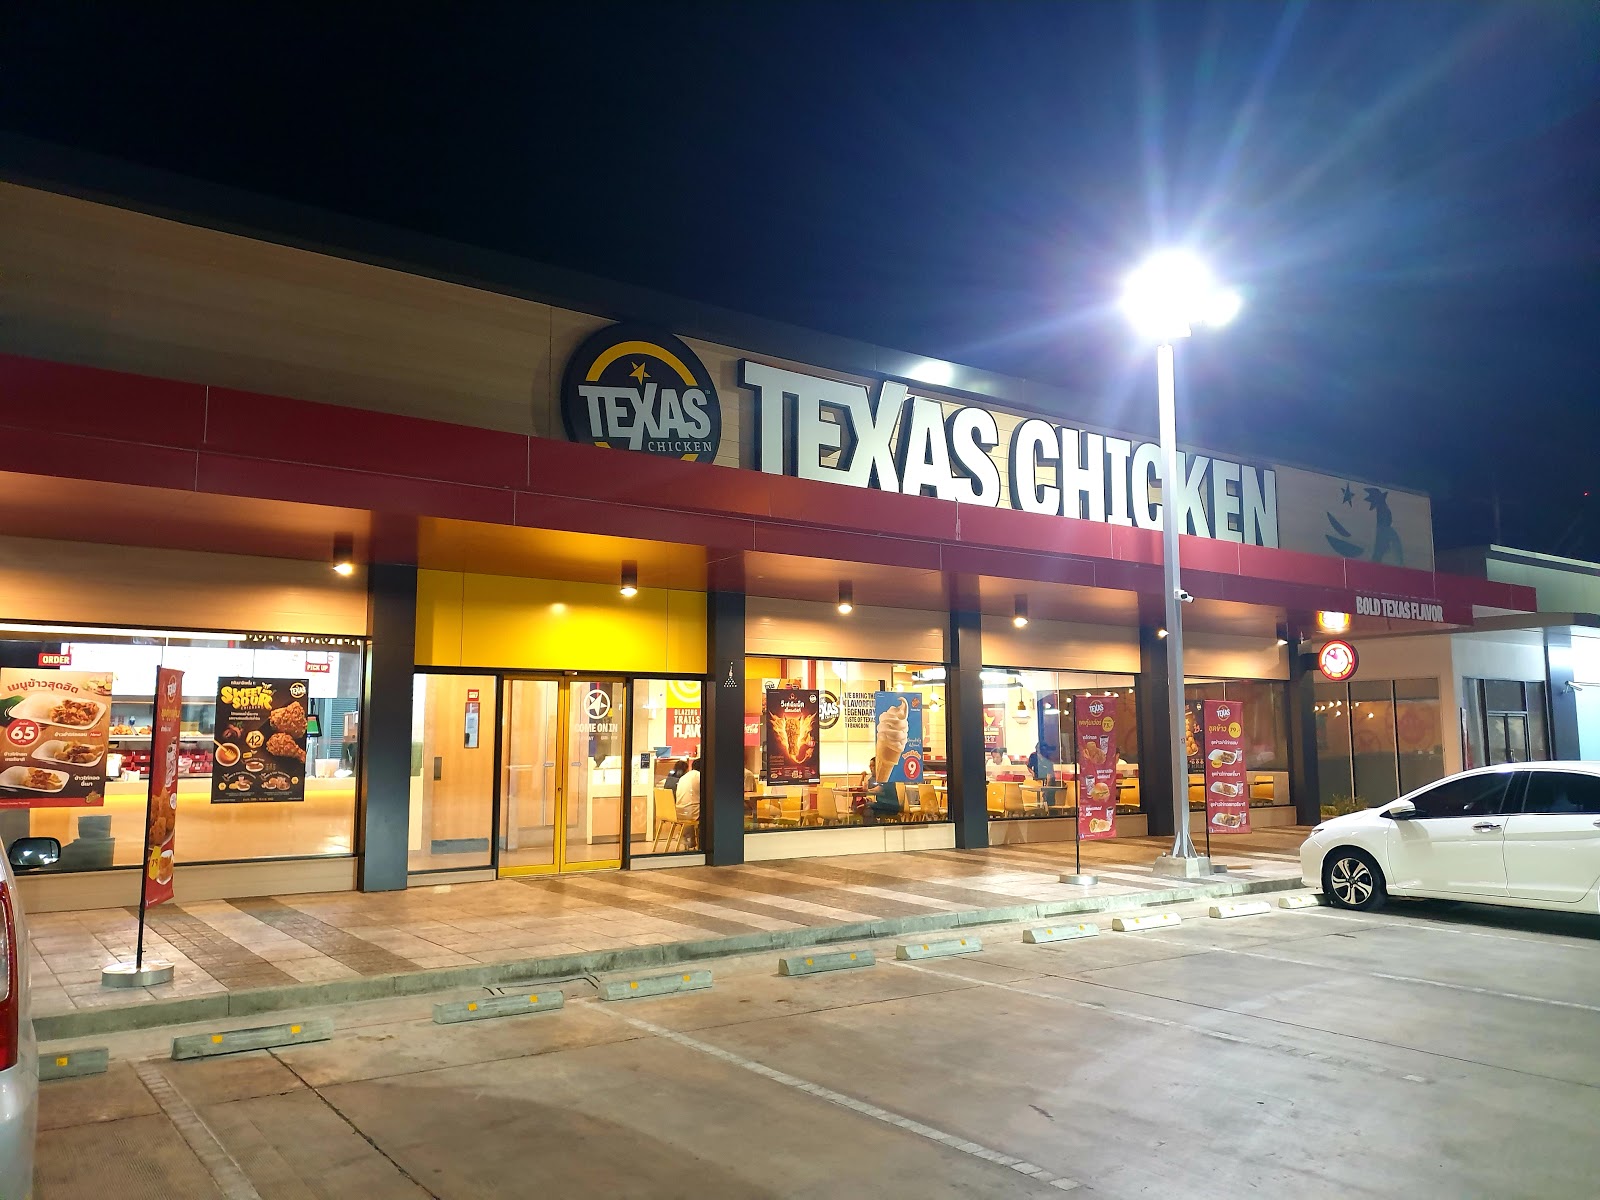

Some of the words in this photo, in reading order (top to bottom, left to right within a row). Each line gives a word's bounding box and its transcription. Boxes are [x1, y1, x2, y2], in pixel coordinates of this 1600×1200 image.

[578, 382, 711, 450] TEXAS
[647, 441, 712, 452] CHICKEN
[745, 361, 1000, 508] TEXAS
[1015, 418, 1279, 549] CHICKEN
[1356, 596, 1380, 616] BOLD
[1381, 599, 1411, 619] TEXAS
[1411, 602, 1444, 623] FLAVOR
[42, 655, 70, 664] ORDER
[7, 678, 79, 694] เมนูข้าวสุดฮิต
[220, 686, 262, 704] SWEET
[232, 693, 273, 710] SOUR
[674, 716, 701, 724] TRAILS
[10, 726, 36, 741] 65
[575, 723, 597, 733] COME
[597, 723, 608, 732] ON
[608, 723, 618, 732] IN
[248, 735, 261, 746] 42
[907, 761, 917, 775] 9
